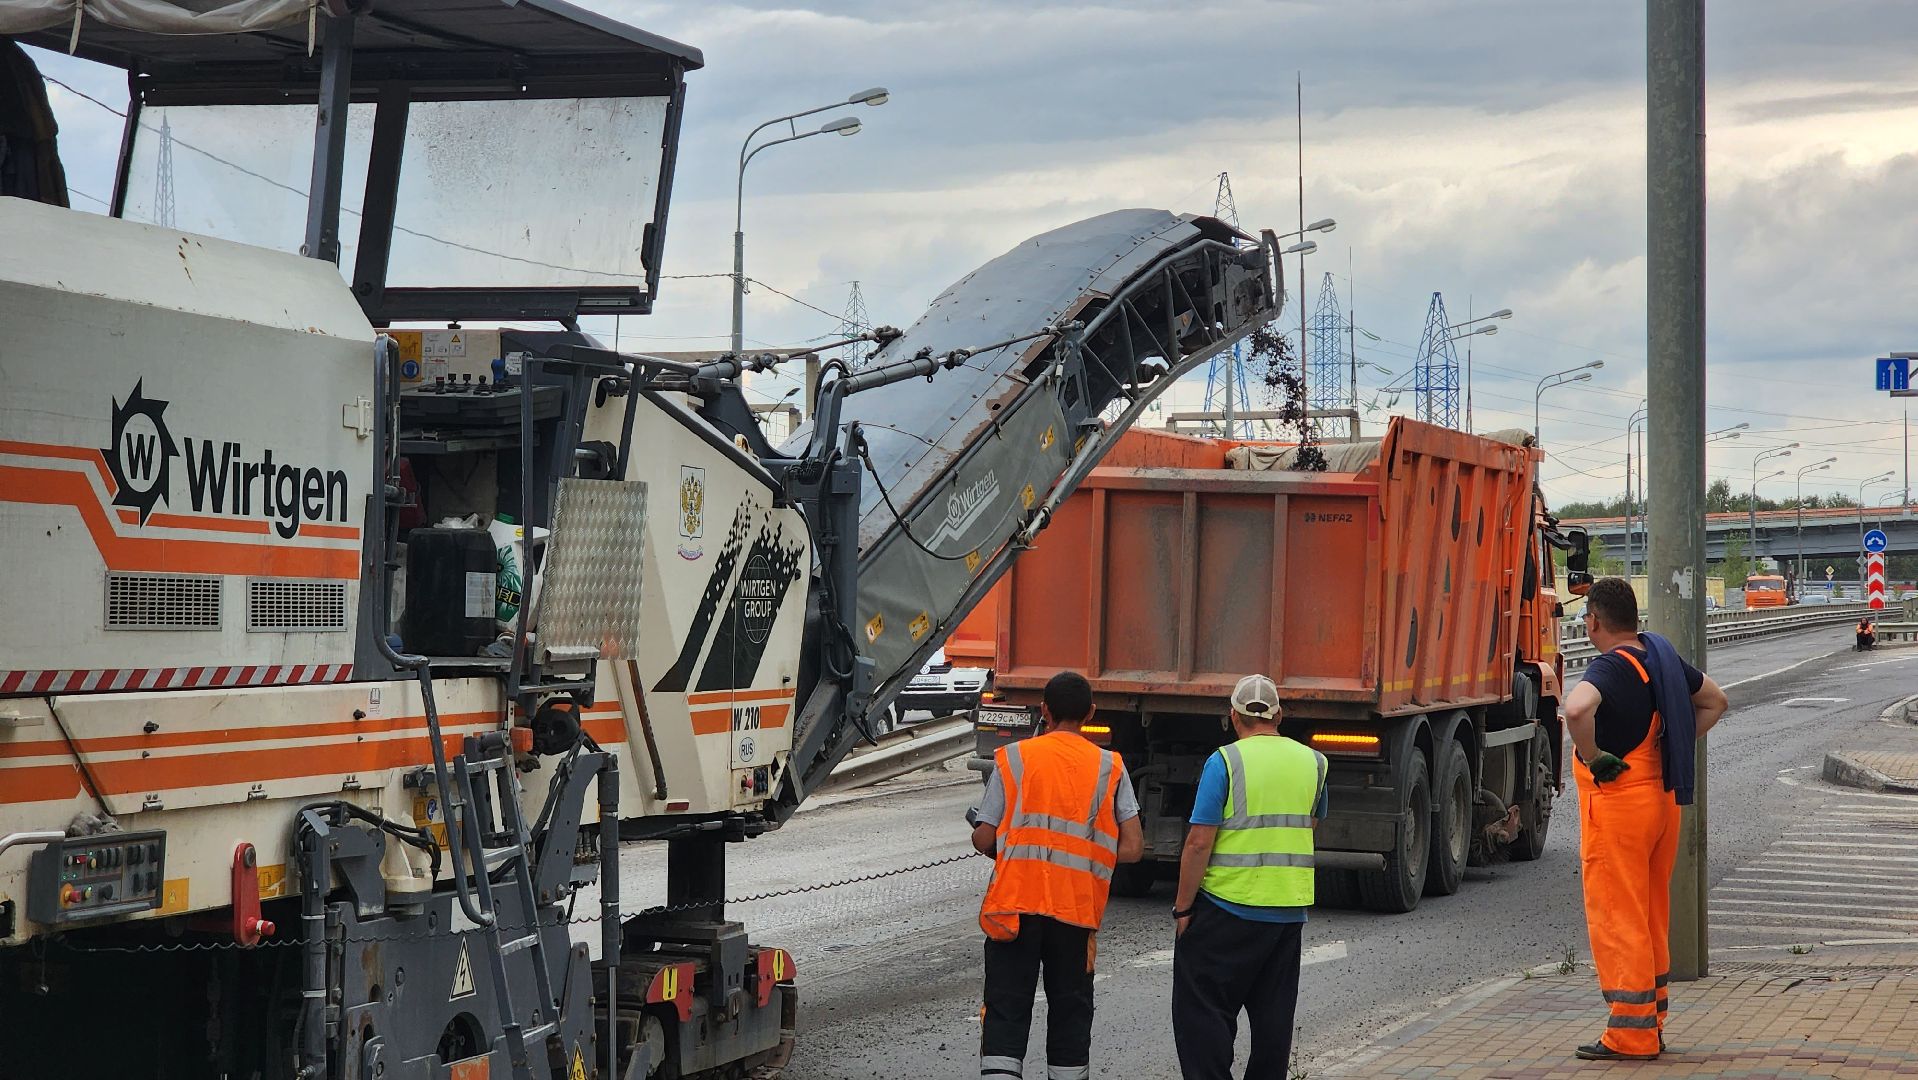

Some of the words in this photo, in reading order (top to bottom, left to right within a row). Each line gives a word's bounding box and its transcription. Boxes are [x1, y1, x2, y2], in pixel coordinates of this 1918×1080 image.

[126, 432, 156, 481] W
[184, 437, 348, 539] Wirtgen
[960, 468, 995, 512] Wirtgen
[740, 579, 776, 597] WIRTGEN
[744, 600, 772, 618] GROUP
[733, 707, 743, 732] W
[744, 706, 760, 731] 210
[741, 742, 754, 756] RUS
